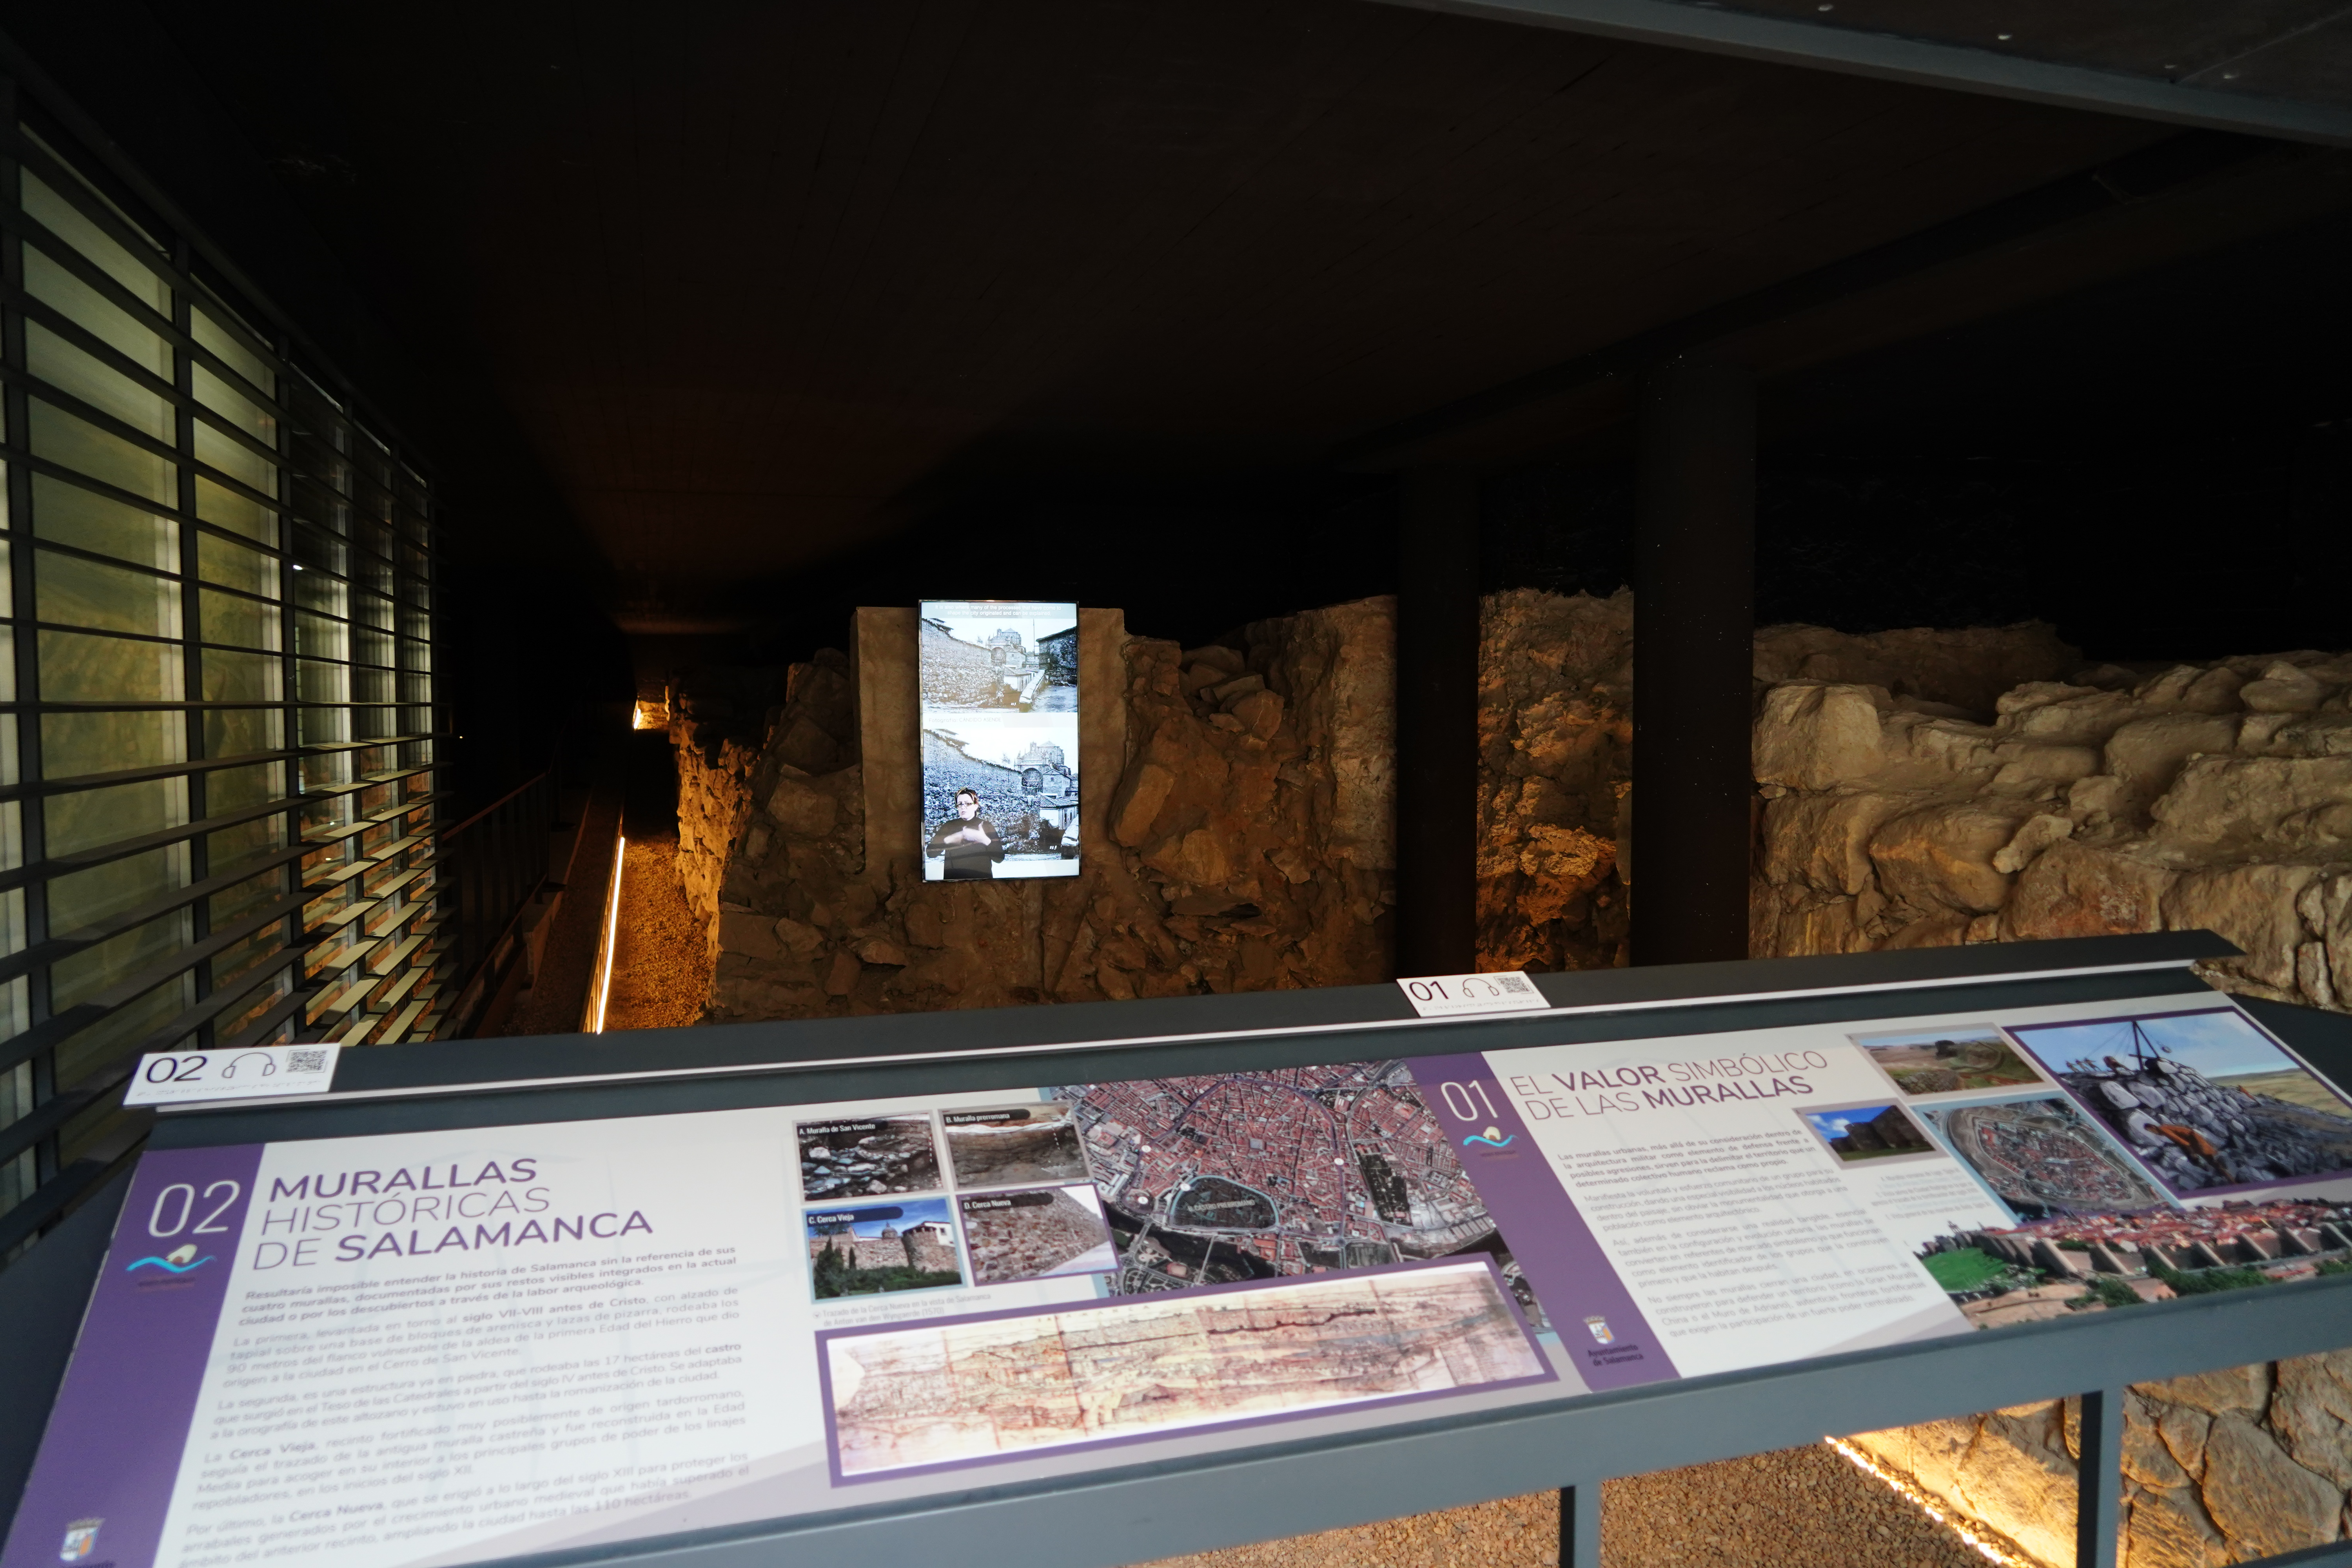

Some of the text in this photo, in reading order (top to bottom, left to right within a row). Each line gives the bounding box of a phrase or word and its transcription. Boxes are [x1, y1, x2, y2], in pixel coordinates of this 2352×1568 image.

[1408, 980, 1450, 1001] 01
[146, 1055, 208, 1083] 02
[1510, 1051, 1827, 1096] EL VALOR SIMBÓLICO
[1441, 1080, 1498, 1121] 01
[1524, 1075, 1813, 1120] DE LAS MURALLAS
[954, 1114, 976, 1123] Muralla
[976, 1113, 1011, 1122] prerromana
[1710, 1134, 1763, 1144] consideración
[1570, 1170, 1605, 1180] posibles
[1606, 1165, 1653, 1175] agresiones,
[1709, 1154, 1743, 1163] delimitar
[1752, 1149, 1788, 1158] territorio
[1575, 1176, 1629, 1187] determinado
[1630, 1172, 1668, 1181] colectivo
[1760, 1159, 1790, 1167] propio.
[1576, 1158, 1627, 1168] arquitectura
[1687, 1147, 1724, 1156] elemento
[269, 1158, 537, 1202] MURALLAS
[148, 1180, 240, 1238] 02
[261, 1187, 550, 1236] HISTÓRICAS
[253, 1210, 653, 1270] DE SALAMANCA
[241, 1302, 285, 1312] cuatro
[290, 1296, 349, 1307] murallas,
[355, 1286, 450, 1301] documentadas
[454, 1283, 476, 1293] por
[506, 1277, 544, 1286] restos
[549, 1272, 594, 1282] visibles
[599, 1265, 663, 1277] integrados
[701, 1257, 736, 1267] actual
[245, 1286, 312, 1299] Resultaría
[317, 1280, 379, 1293] imposible
[384, 1275, 441, 1286] entender
[460, 1268, 507, 1278] historia
[531, 1261, 596, 1272] Salamanca
[601, 1257, 618, 1265] sin
[636, 1250, 694, 1261] referencia
[238, 1314, 285, 1325] ciudad
[300, 1311, 323, 1321] por
[327, 1308, 346, 1316] los
[350, 1300, 434, 1314] descubiertos
[450, 1293, 489, 1304] través
[527, 1287, 558, 1296] labor
[563, 1279, 643, 1293] arqueológica.
[822, 1308, 849, 1317] Trazado
[955, 1294, 991, 1303] Salamanca
[883, 1310, 920, 1321] Wyngaerde
[922, 1307, 944, 1318] (1570)
[1588, 1345, 1639, 1358] Ayuntamiento
[1603, 1354, 1644, 1365] Salamanca
